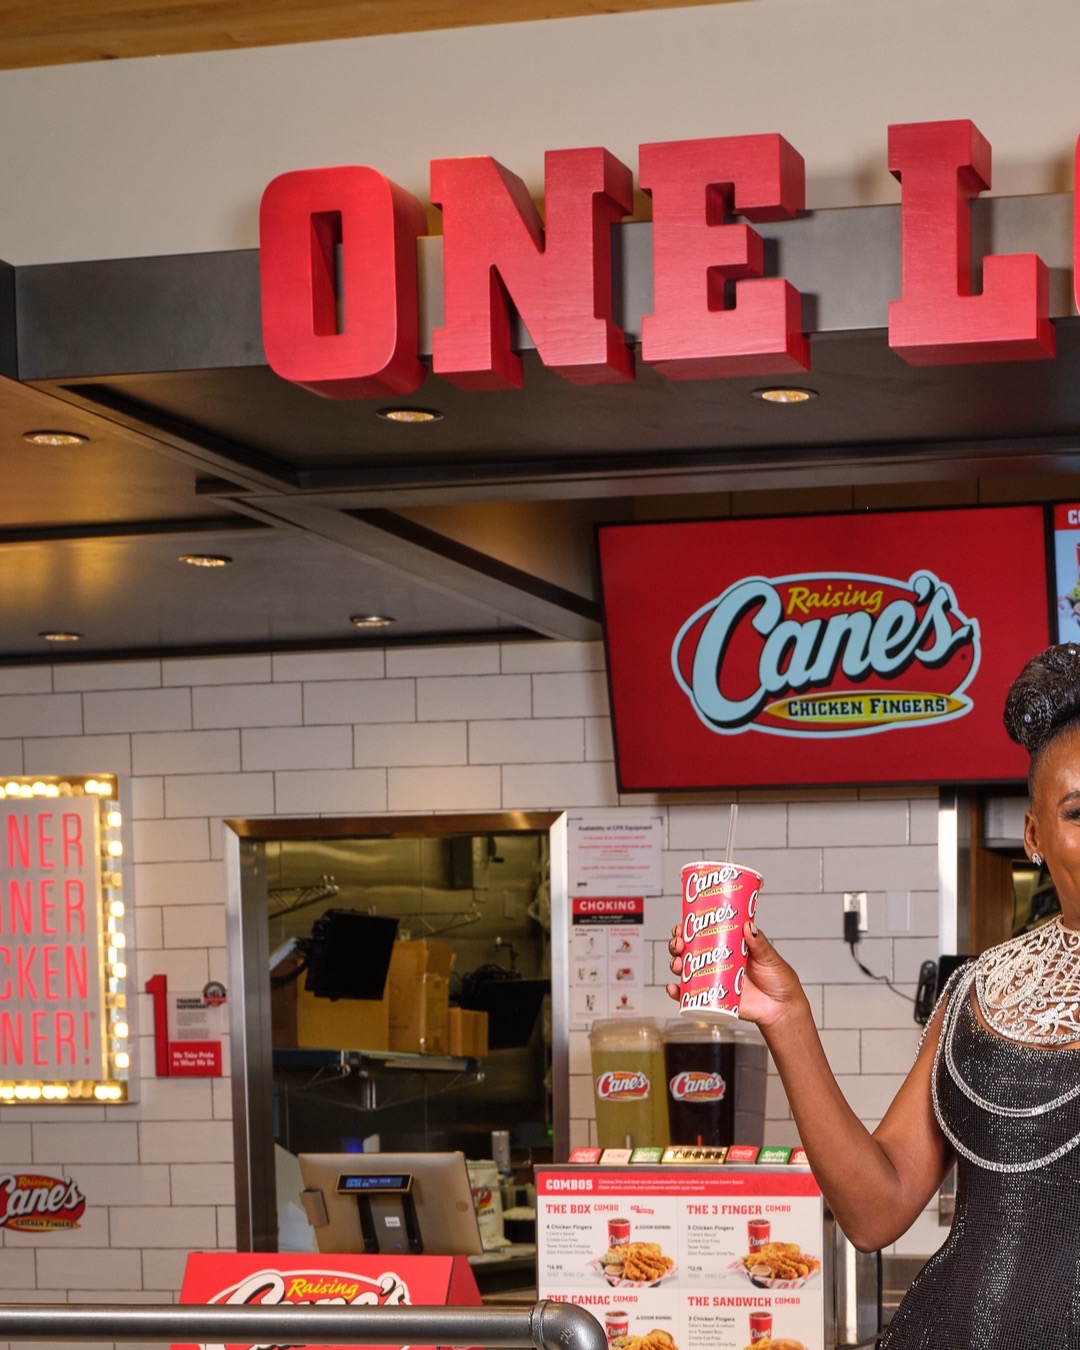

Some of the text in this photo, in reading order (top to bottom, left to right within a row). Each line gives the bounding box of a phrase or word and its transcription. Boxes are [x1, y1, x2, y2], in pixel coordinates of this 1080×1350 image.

[259, 132, 811, 398] ONE
[785, 585, 883, 614] Raising
[693, 575, 973, 727] Cane's
[787, 697, 946, 717] CHICKEN FINGERS
[7, 813, 83, 869] NER
[686, 866, 742, 903] Cane's
[580, 901, 636, 911] CHOKING
[683, 902, 738, 943] Cane's
[682, 942, 732, 982] Cane's
[680, 982, 728, 1009] Cane's
[598, 1071, 648, 1098] Cane's
[672, 1071, 723, 1099] Cane's
[636, 1150, 660, 1159] Sprite
[546, 1179, 593, 1190] COMBOS
[546, 1204, 567, 1214] THE
[570, 1204, 591, 1214] BOX
[687, 1205, 708, 1214] THE
[712, 1205, 718, 1214] 3
[722, 1205, 762, 1215] FINGER
[287, 1278, 358, 1298] Raising
[571, 1295, 610, 1305] CANIAC
[688, 1297, 709, 1306] THE
[713, 1297, 772, 1307] SANDWICH
